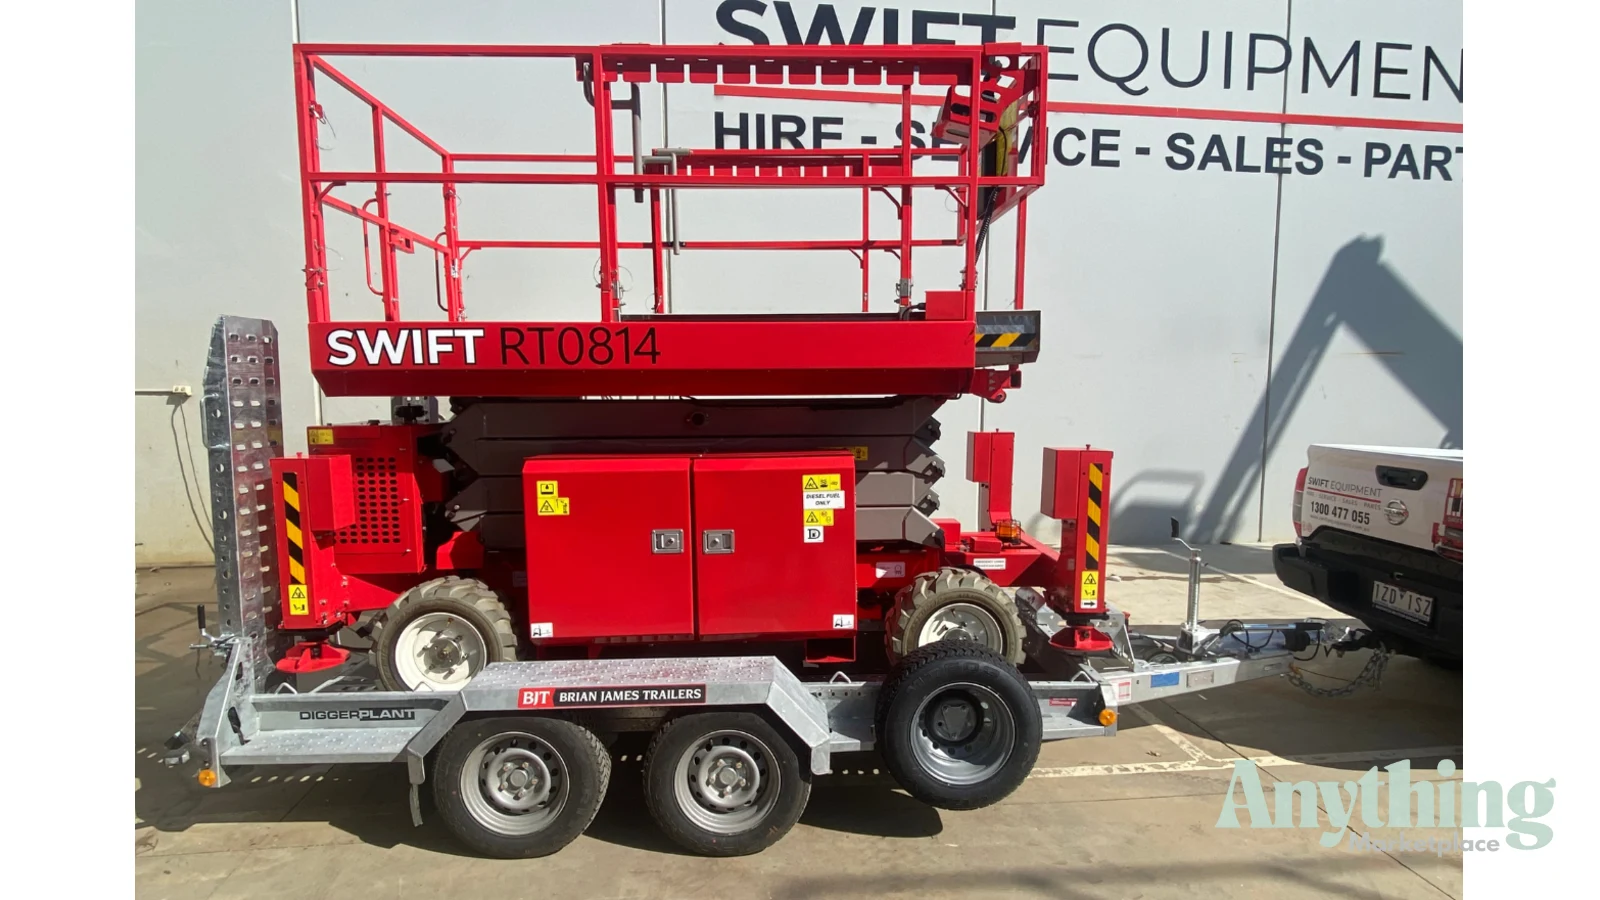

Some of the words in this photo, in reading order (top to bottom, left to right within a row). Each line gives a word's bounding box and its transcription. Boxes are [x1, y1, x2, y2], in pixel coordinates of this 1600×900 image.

[1165, 132, 1324, 175] SALES
[326, 328, 485, 366] SWIFT
[501, 327, 661, 366] RT0814
[1308, 476, 1329, 488] SWIFT
[1330, 481, 1383, 498] EQUIPMENT
[1311, 501, 1330, 516] 1300
[1332, 506, 1349, 520] 477
[1351, 510, 1370, 525] 055
[523, 690, 550, 706] BJT
[559, 692, 597, 703] BRIAN
[600, 690, 639, 703] JAMES
[642, 688, 702, 700] TRAILERS
